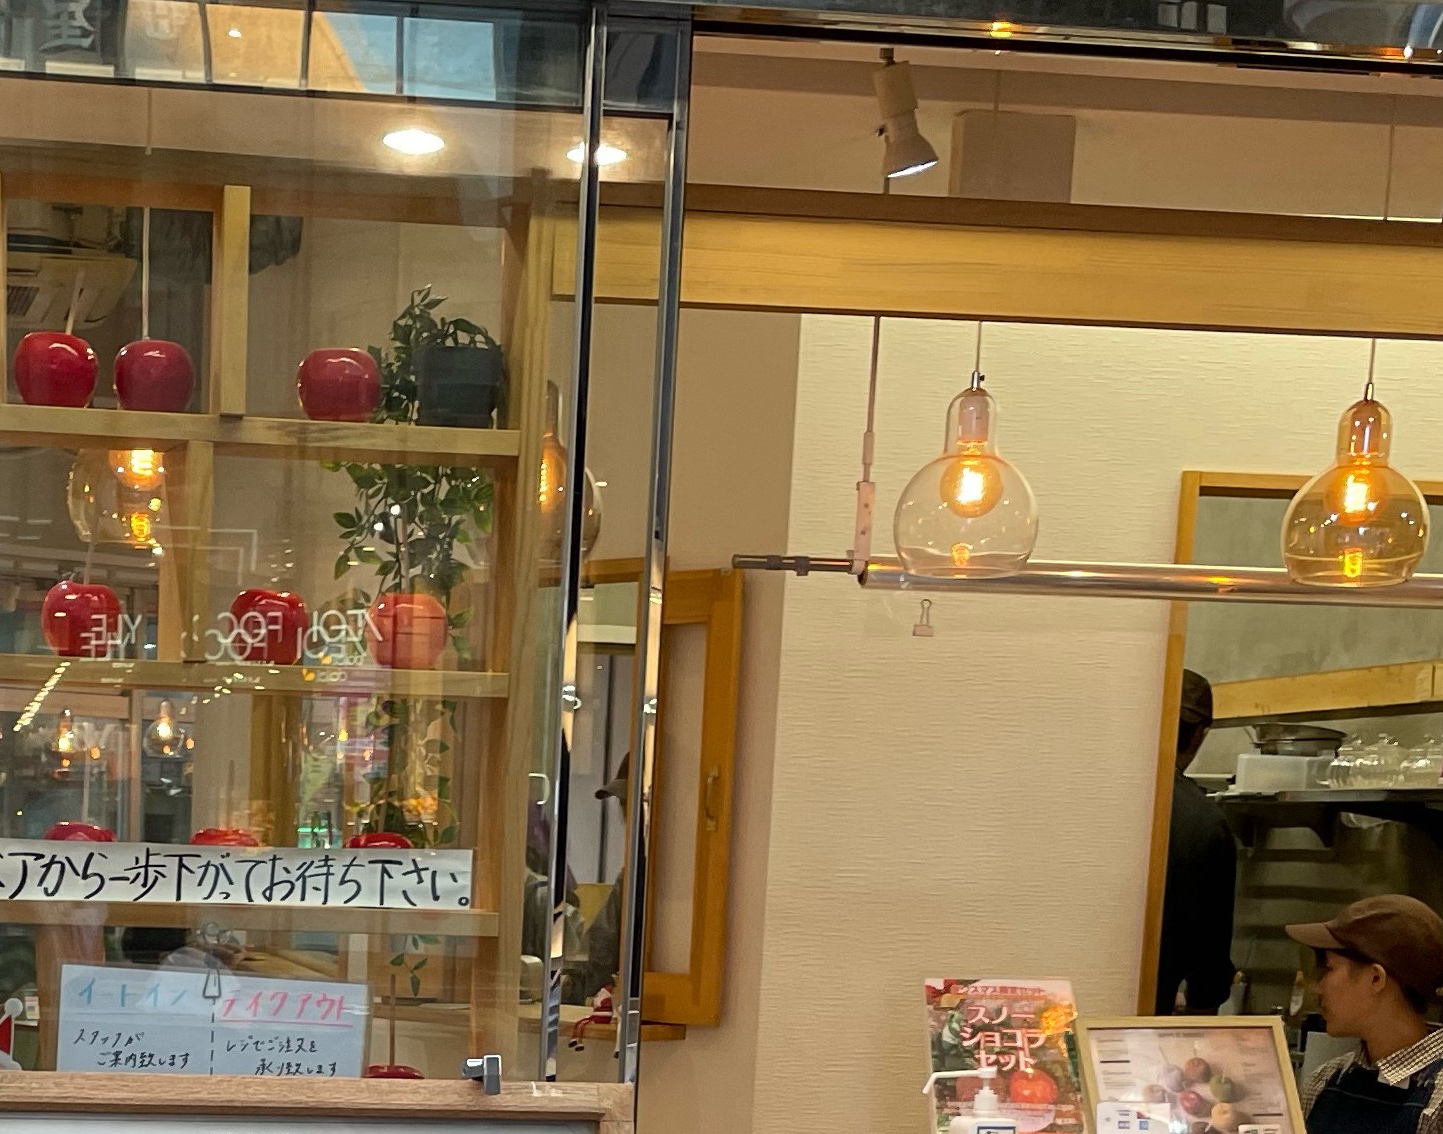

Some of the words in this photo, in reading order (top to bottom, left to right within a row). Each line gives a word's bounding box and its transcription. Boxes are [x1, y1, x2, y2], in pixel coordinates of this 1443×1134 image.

[220, 989, 348, 1021] テイクアウト
[967, 1005, 1036, 1025] スノー
[959, 1028, 1048, 1048] ショコラ
